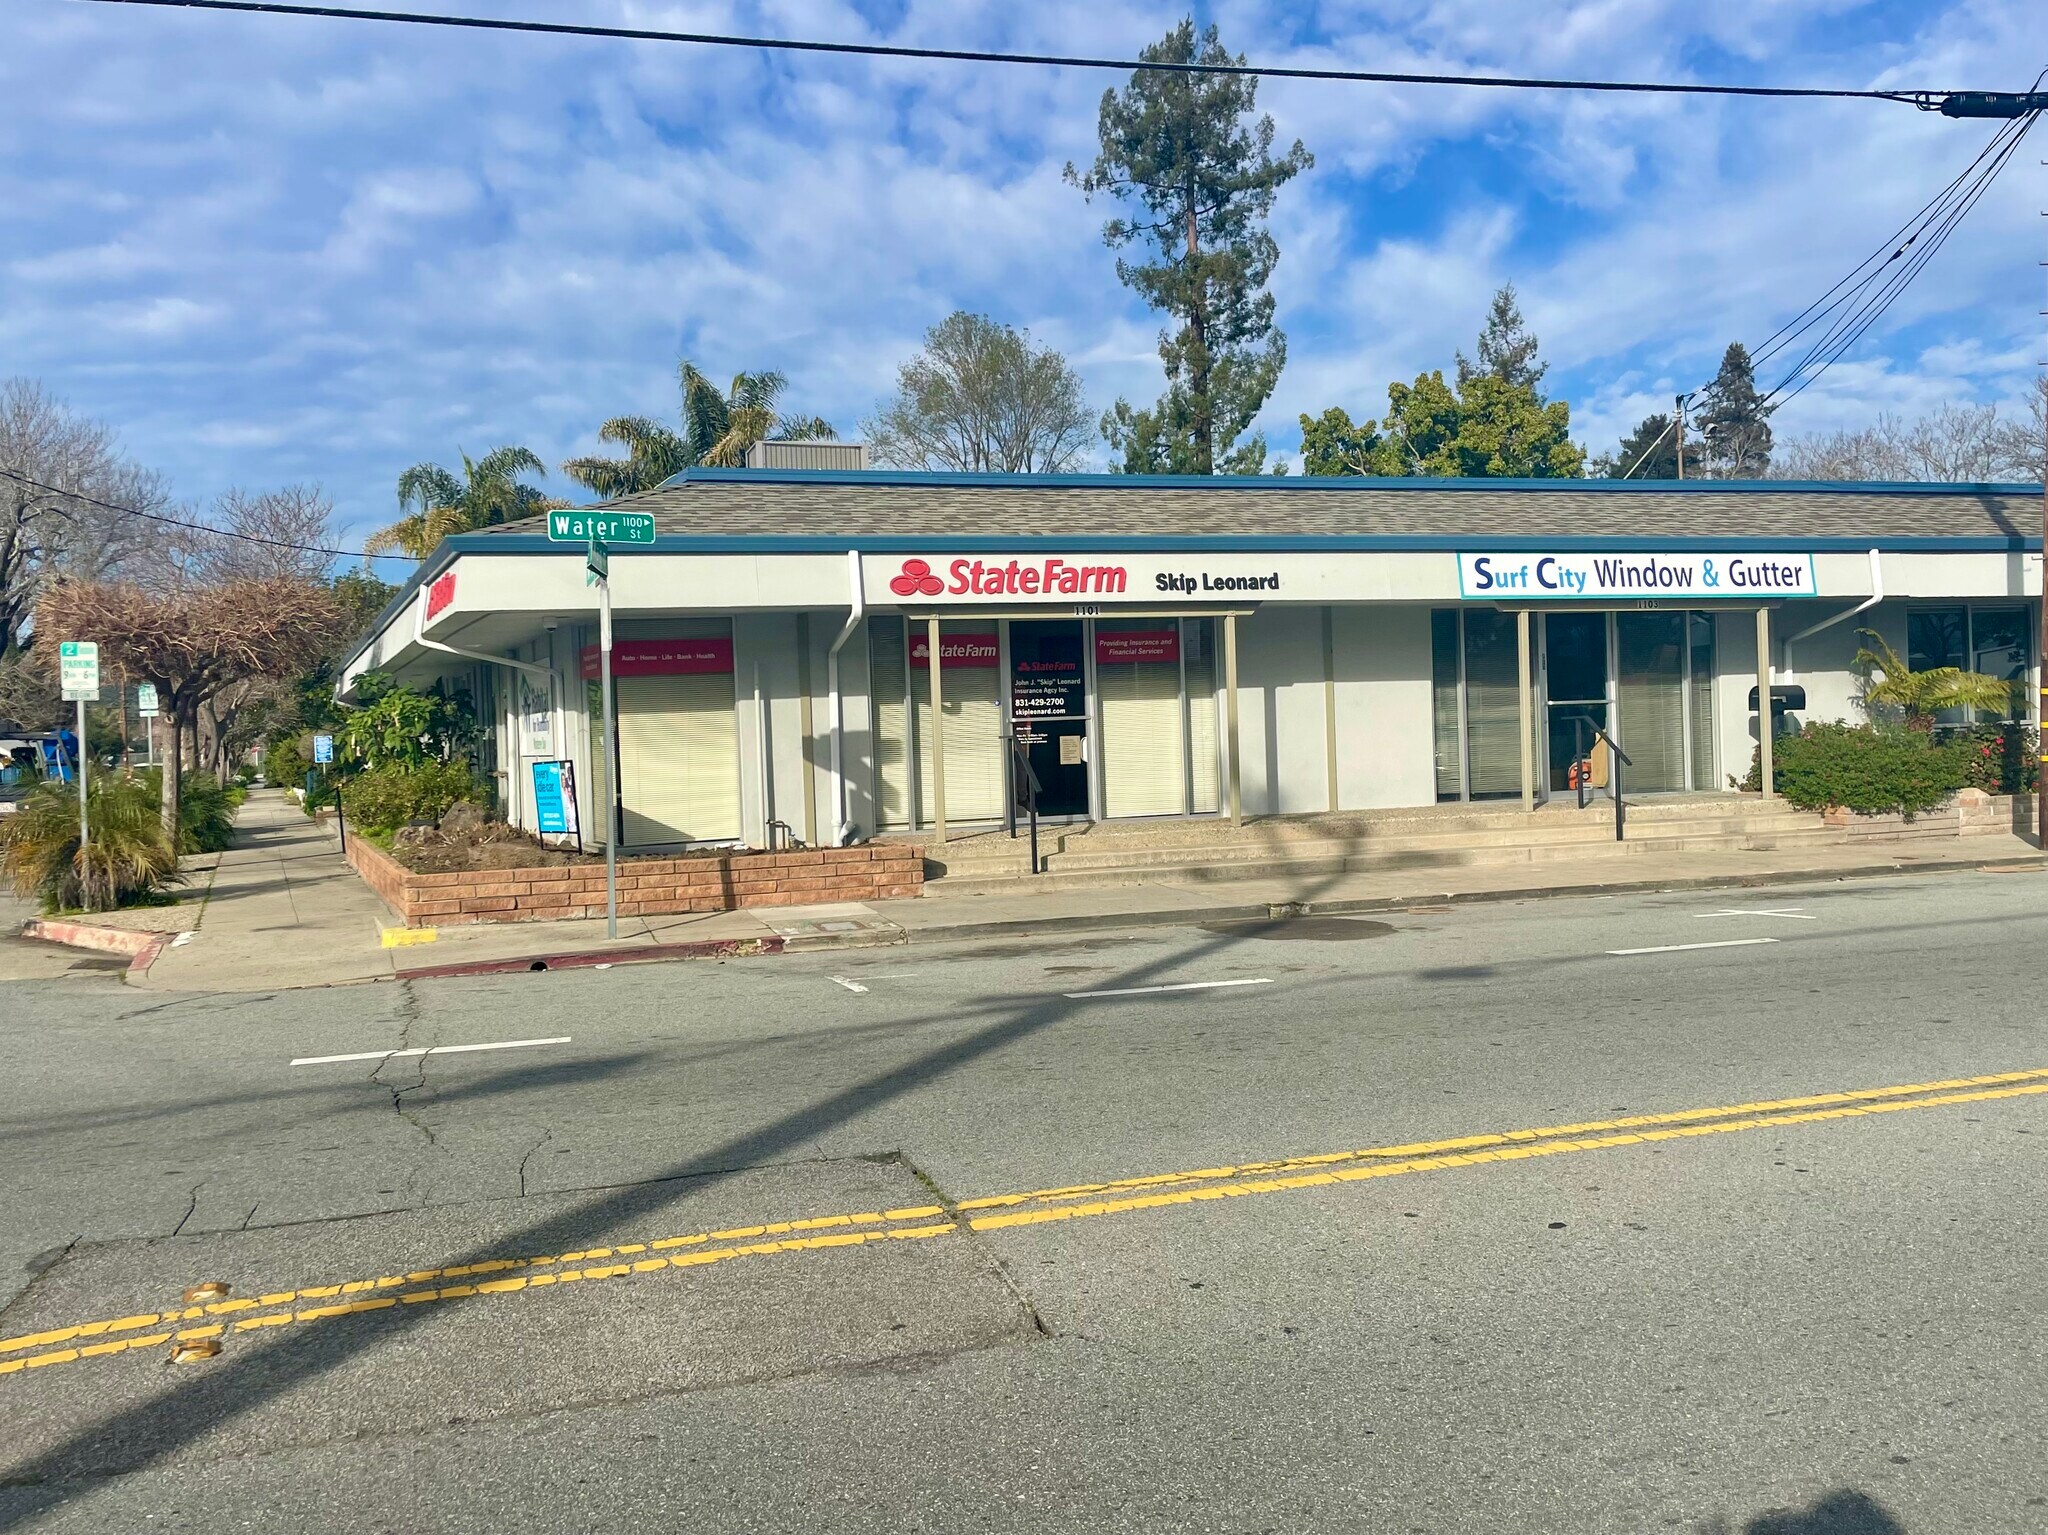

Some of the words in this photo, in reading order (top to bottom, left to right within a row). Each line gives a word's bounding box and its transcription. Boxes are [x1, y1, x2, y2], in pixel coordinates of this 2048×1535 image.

[555, 516, 618, 536] Water
[623, 517, 642, 527] 1100
[630, 529, 641, 539] St
[1474, 557, 1528, 589] Surf
[1536, 557, 1586, 593] City
[1593, 558, 1692, 587] Window
[1702, 559, 1720, 587] &
[1729, 559, 1802, 587] Gutter
[1155, 573, 1197, 595] Skip
[1202, 572, 1279, 590] Leonard
[1638, 600, 1658, 609] 1103
[1075, 606, 1099, 615] 1101
[1099, 639, 1128, 647] Providing
[66, 645, 74, 655] 2
[1015, 698, 1064, 706] 831-429-2700
[1015, 708, 1066, 716] skipleonard.com
